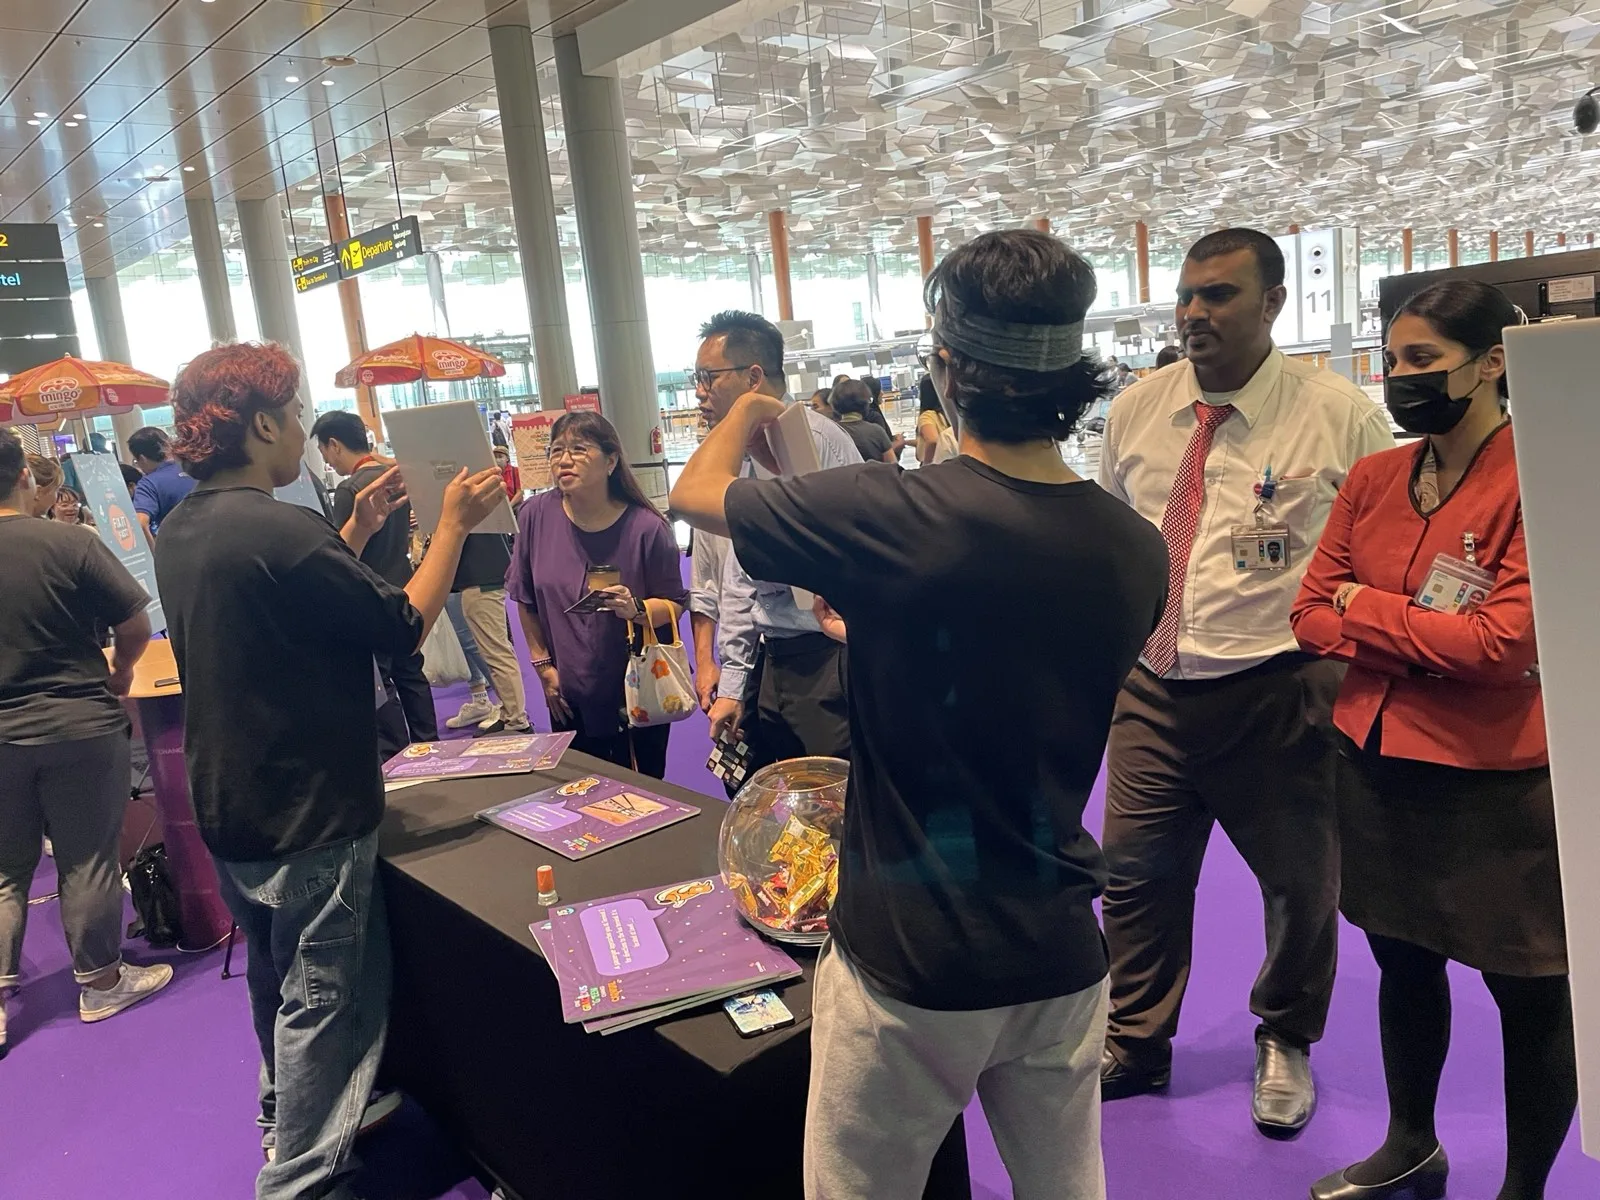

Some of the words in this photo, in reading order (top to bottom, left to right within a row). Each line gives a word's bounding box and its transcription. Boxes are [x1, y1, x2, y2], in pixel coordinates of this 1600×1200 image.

[362, 240, 393, 259] Departure
[0, 273, 21, 286] tel
[1306, 290, 1330, 313] 11
[439, 360, 465, 369] mingo
[41, 390, 78, 402] mingo
